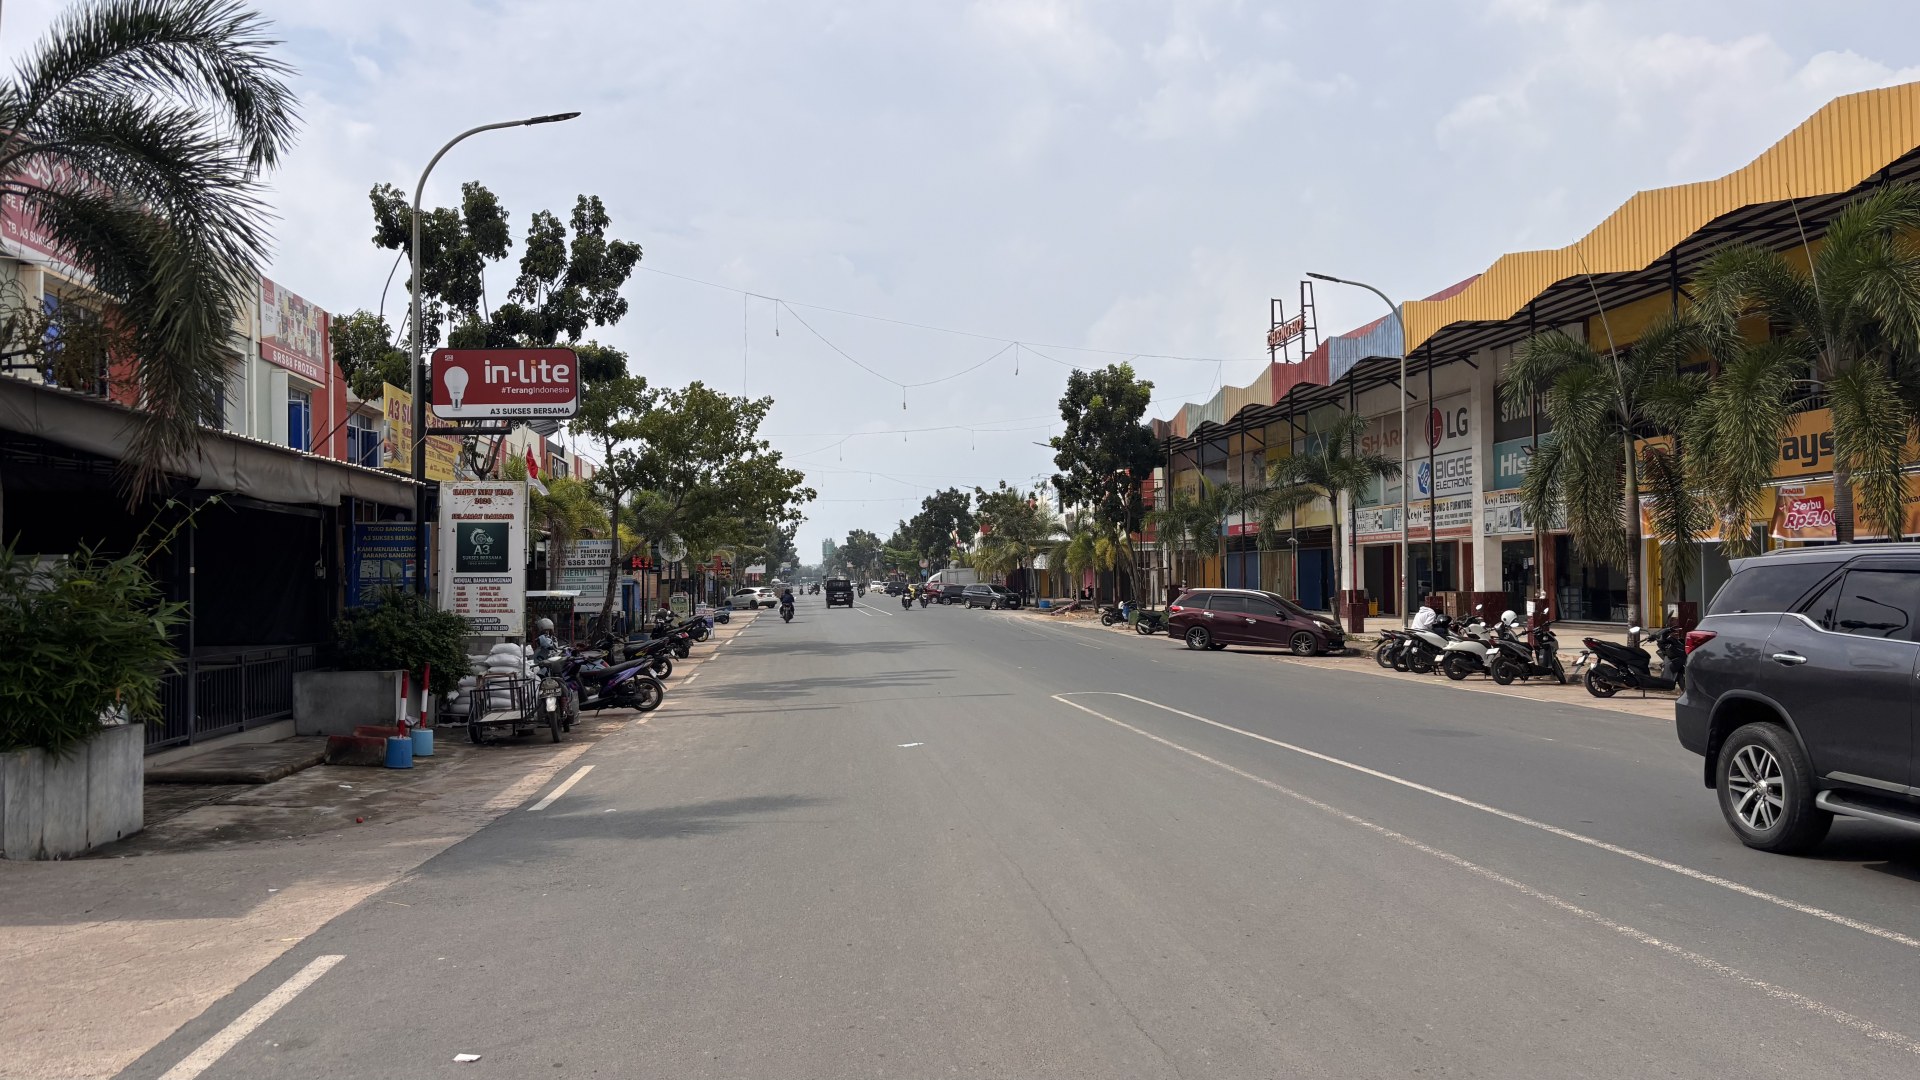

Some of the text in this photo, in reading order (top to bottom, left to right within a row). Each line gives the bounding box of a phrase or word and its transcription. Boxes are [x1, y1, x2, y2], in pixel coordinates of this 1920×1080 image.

[294, 360, 317, 378] FROZEN
[388, 398, 400, 421] A3
[1446, 407, 1469, 439] LG
[1792, 500, 1822, 512] Serbu
[473, 544, 490, 555] A3
[563, 569, 598, 577] HERVINA
